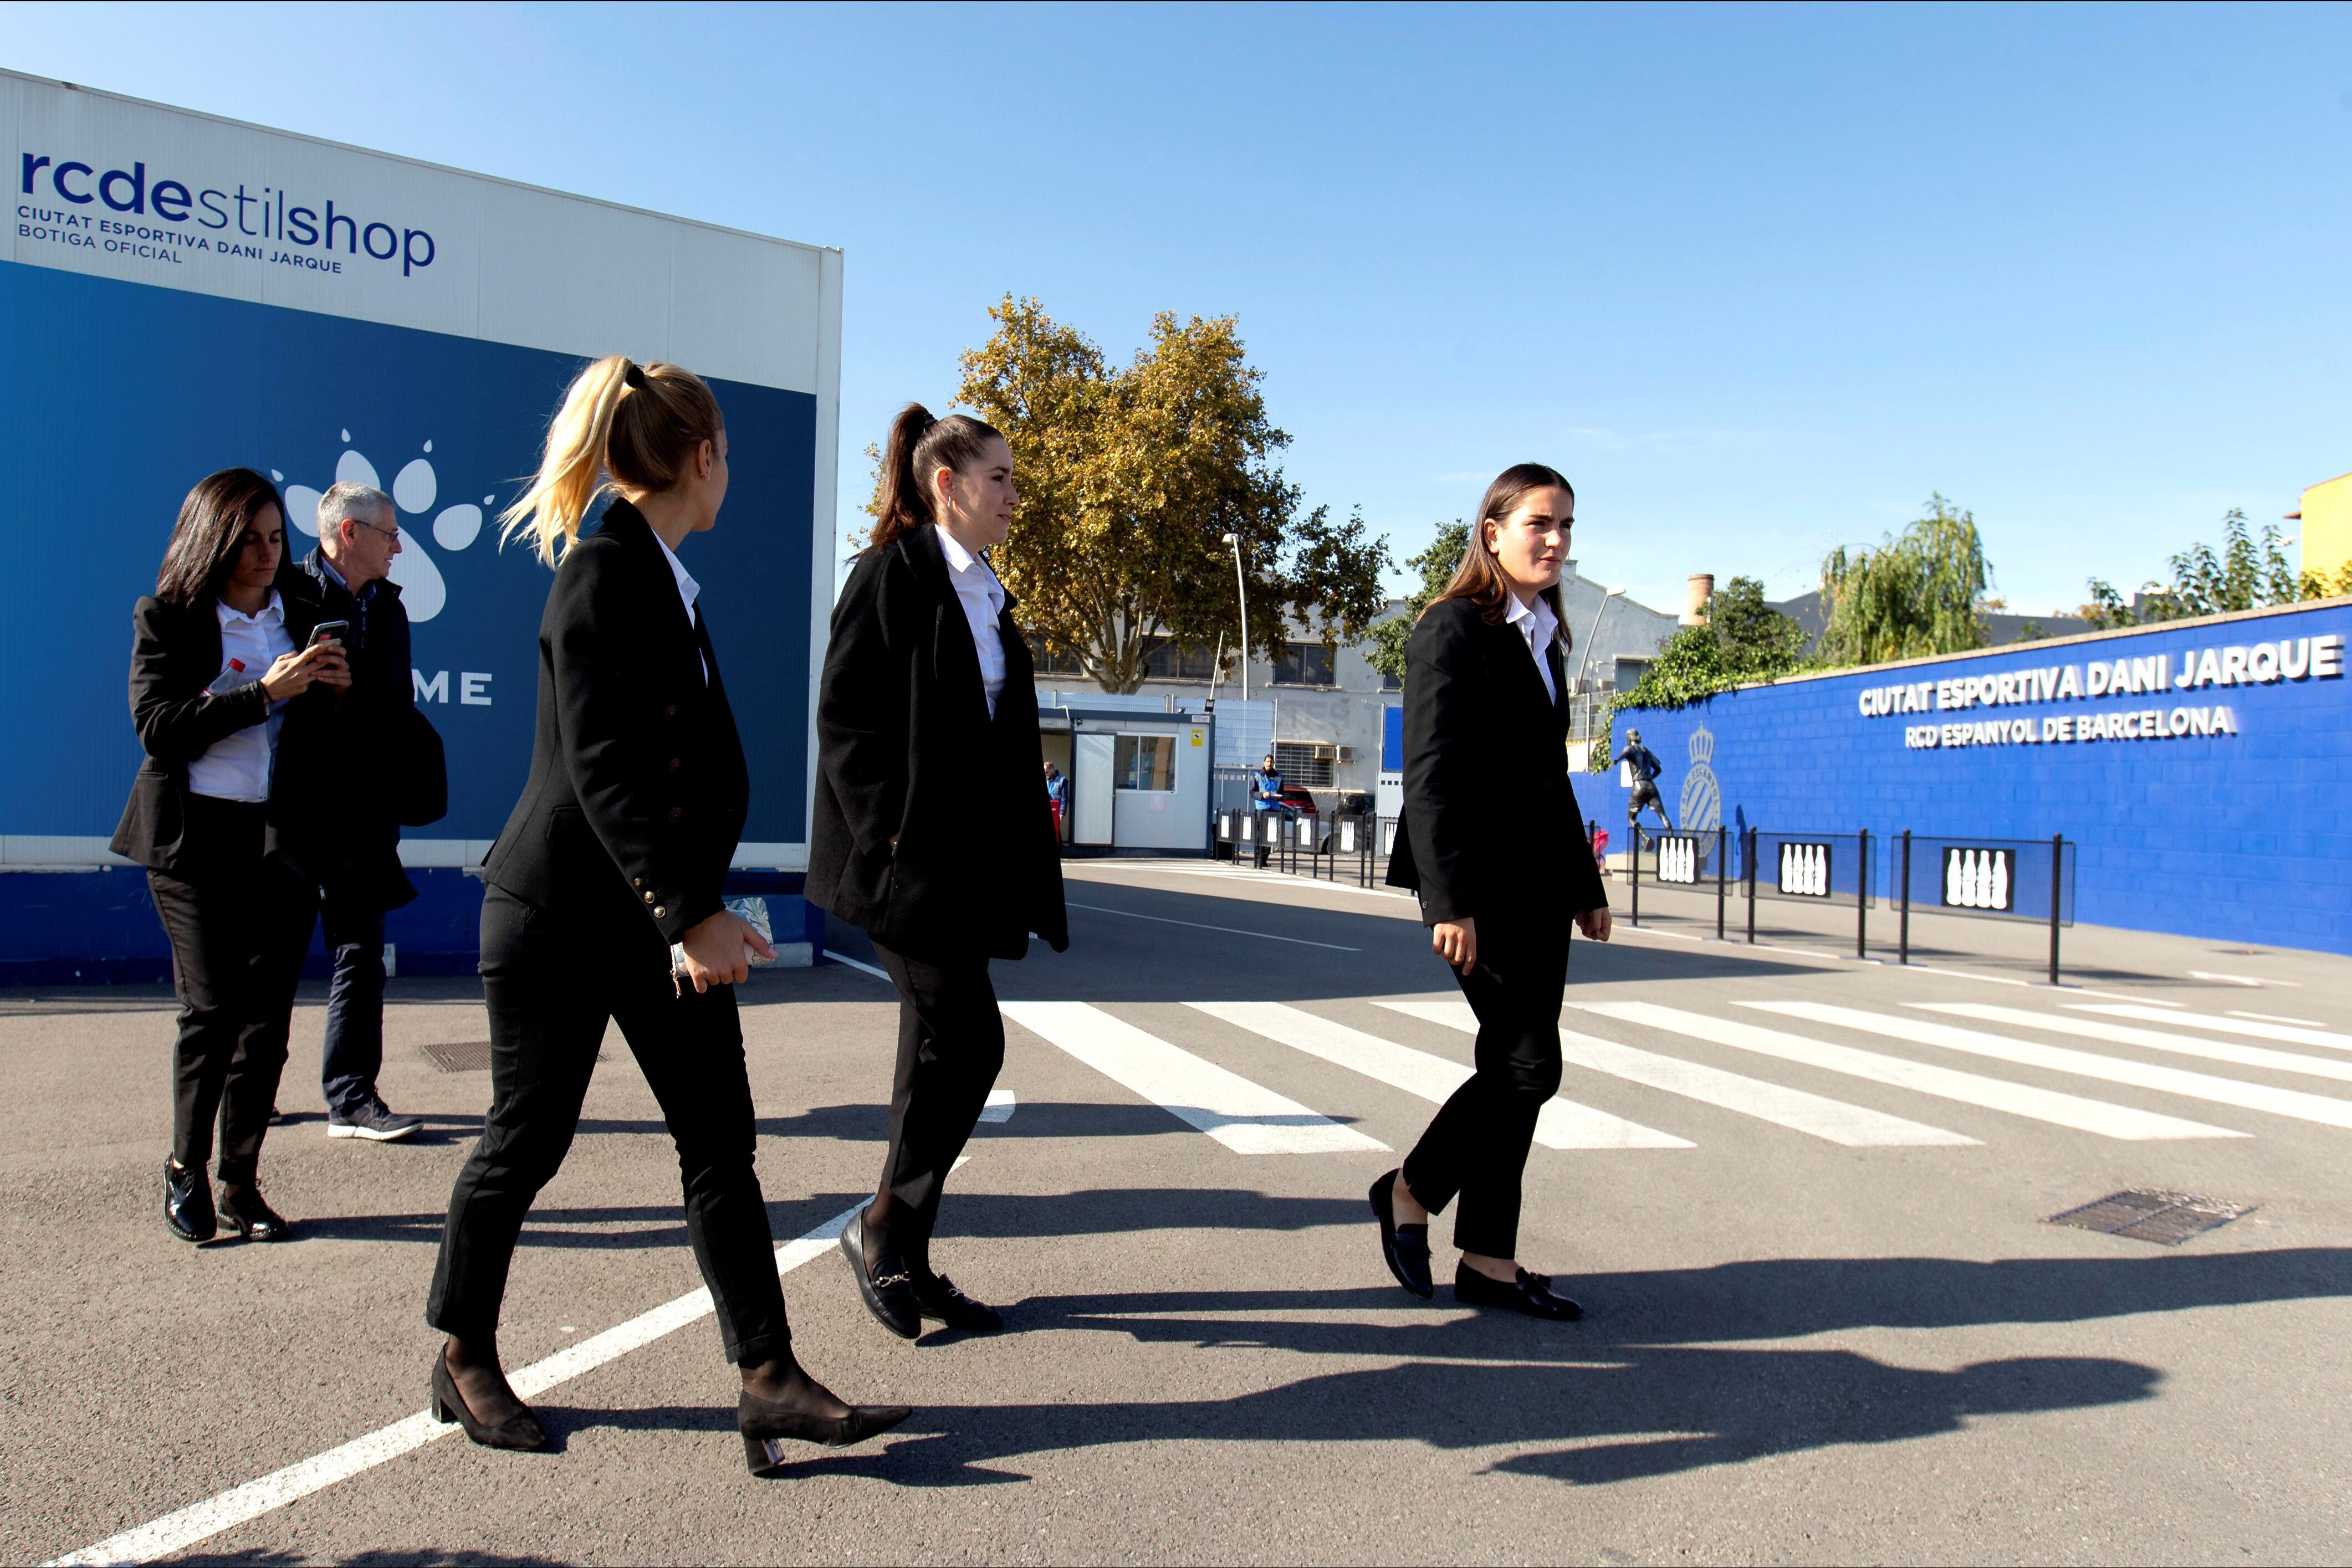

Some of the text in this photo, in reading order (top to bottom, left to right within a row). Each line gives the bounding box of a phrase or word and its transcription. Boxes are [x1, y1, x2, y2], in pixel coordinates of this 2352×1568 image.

[18, 206, 341, 274] CIUTAT ESPORTIVA DANI JARQUE
[22, 153, 435, 277] rcdestilshop
[19, 224, 182, 263] BOTIGA OFICIAL
[411, 669, 492, 705] ME
[1859, 634, 2345, 716] CIUTAT ESPORTIVA DANI JARQUE
[1905, 706, 2237, 748] RCD ESPANYOL DE BARCELONA
